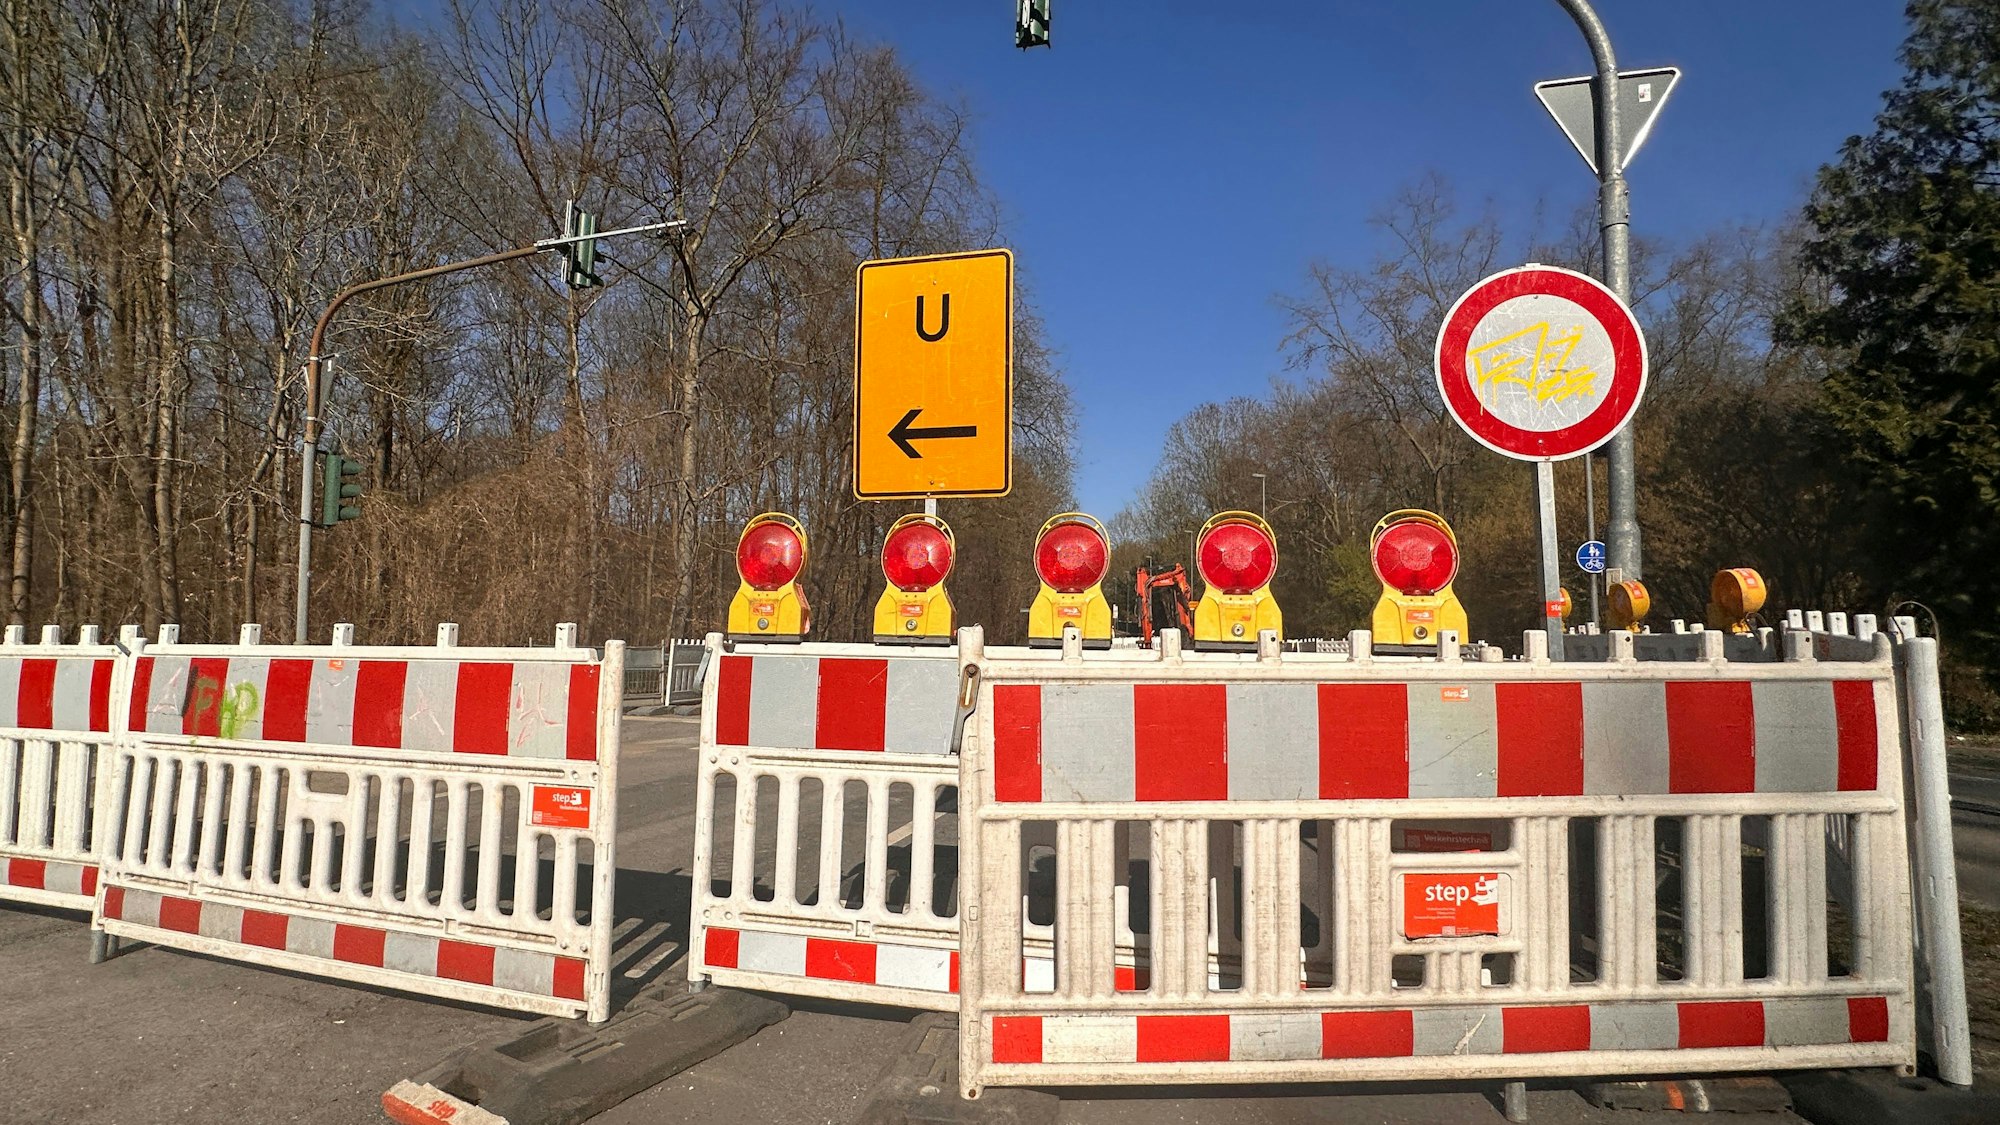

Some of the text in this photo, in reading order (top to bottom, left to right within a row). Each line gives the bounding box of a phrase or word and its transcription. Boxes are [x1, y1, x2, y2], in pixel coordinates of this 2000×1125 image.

[916, 293, 950, 342] U
[552, 793, 571, 805] step
[1425, 884, 1470, 906] step
[426, 1100, 457, 1119] step
